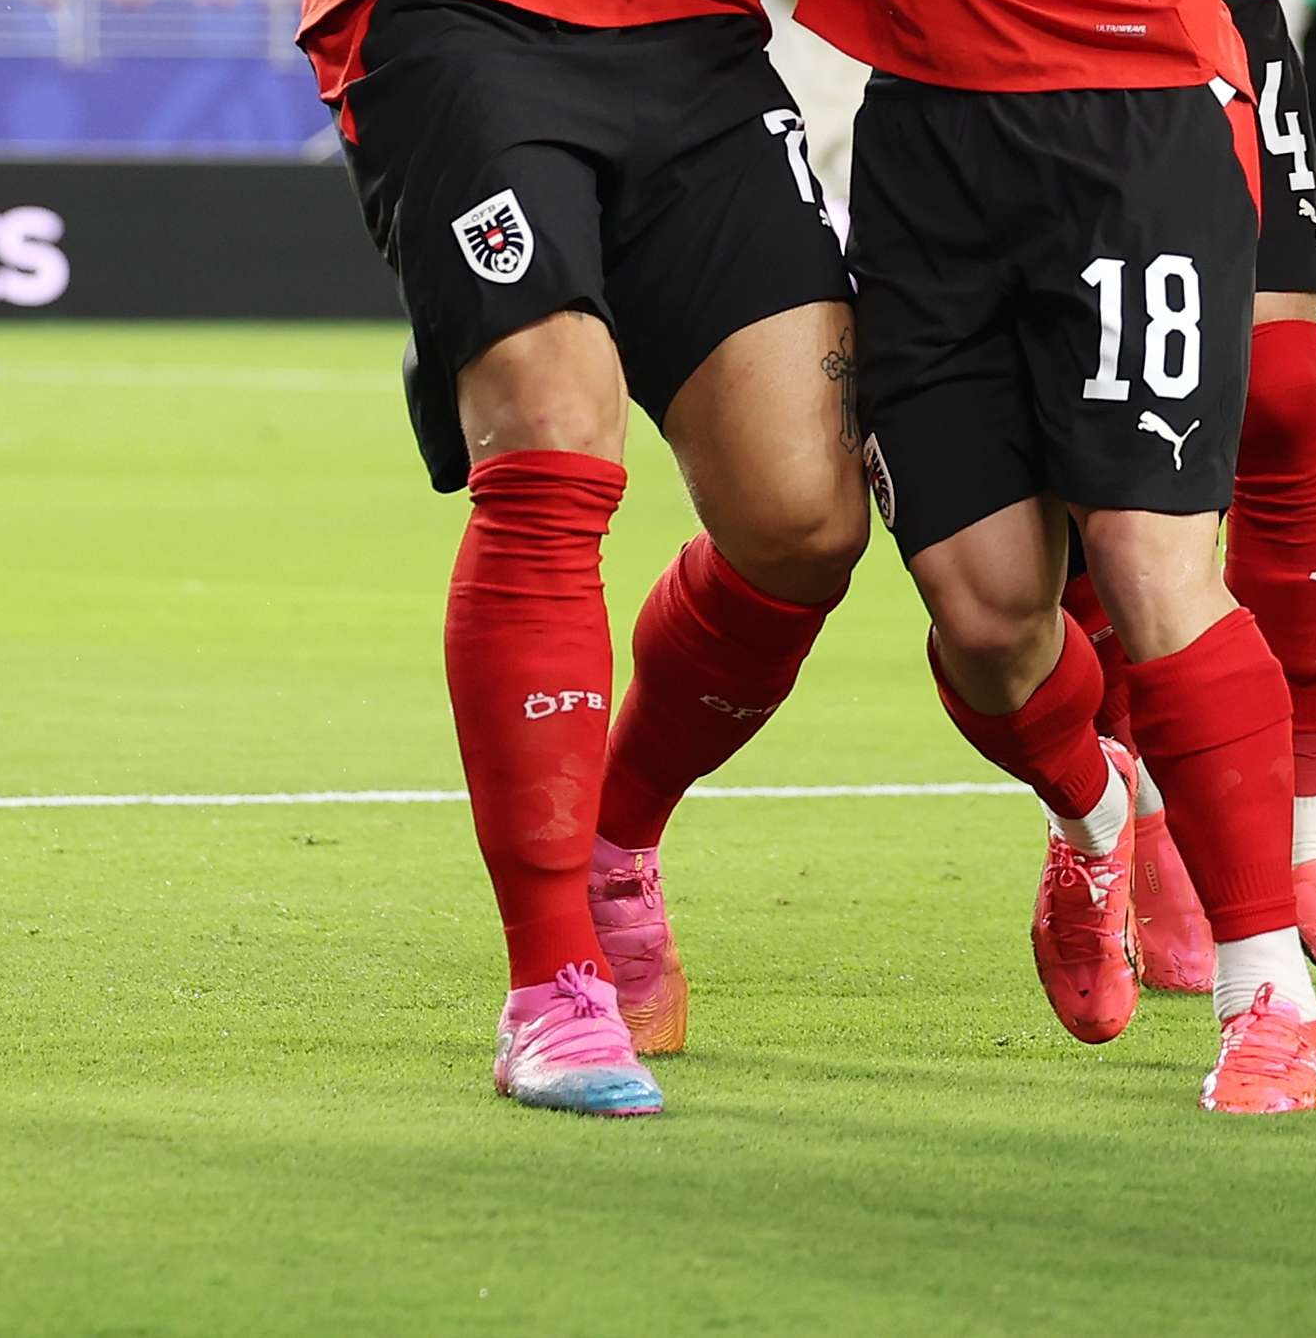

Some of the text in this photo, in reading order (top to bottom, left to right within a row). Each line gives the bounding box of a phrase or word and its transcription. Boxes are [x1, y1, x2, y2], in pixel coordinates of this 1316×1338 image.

[1258, 60, 1316, 191] 4
[1081, 252, 1202, 403] 18
[524, 690, 608, 720] ÖFB
